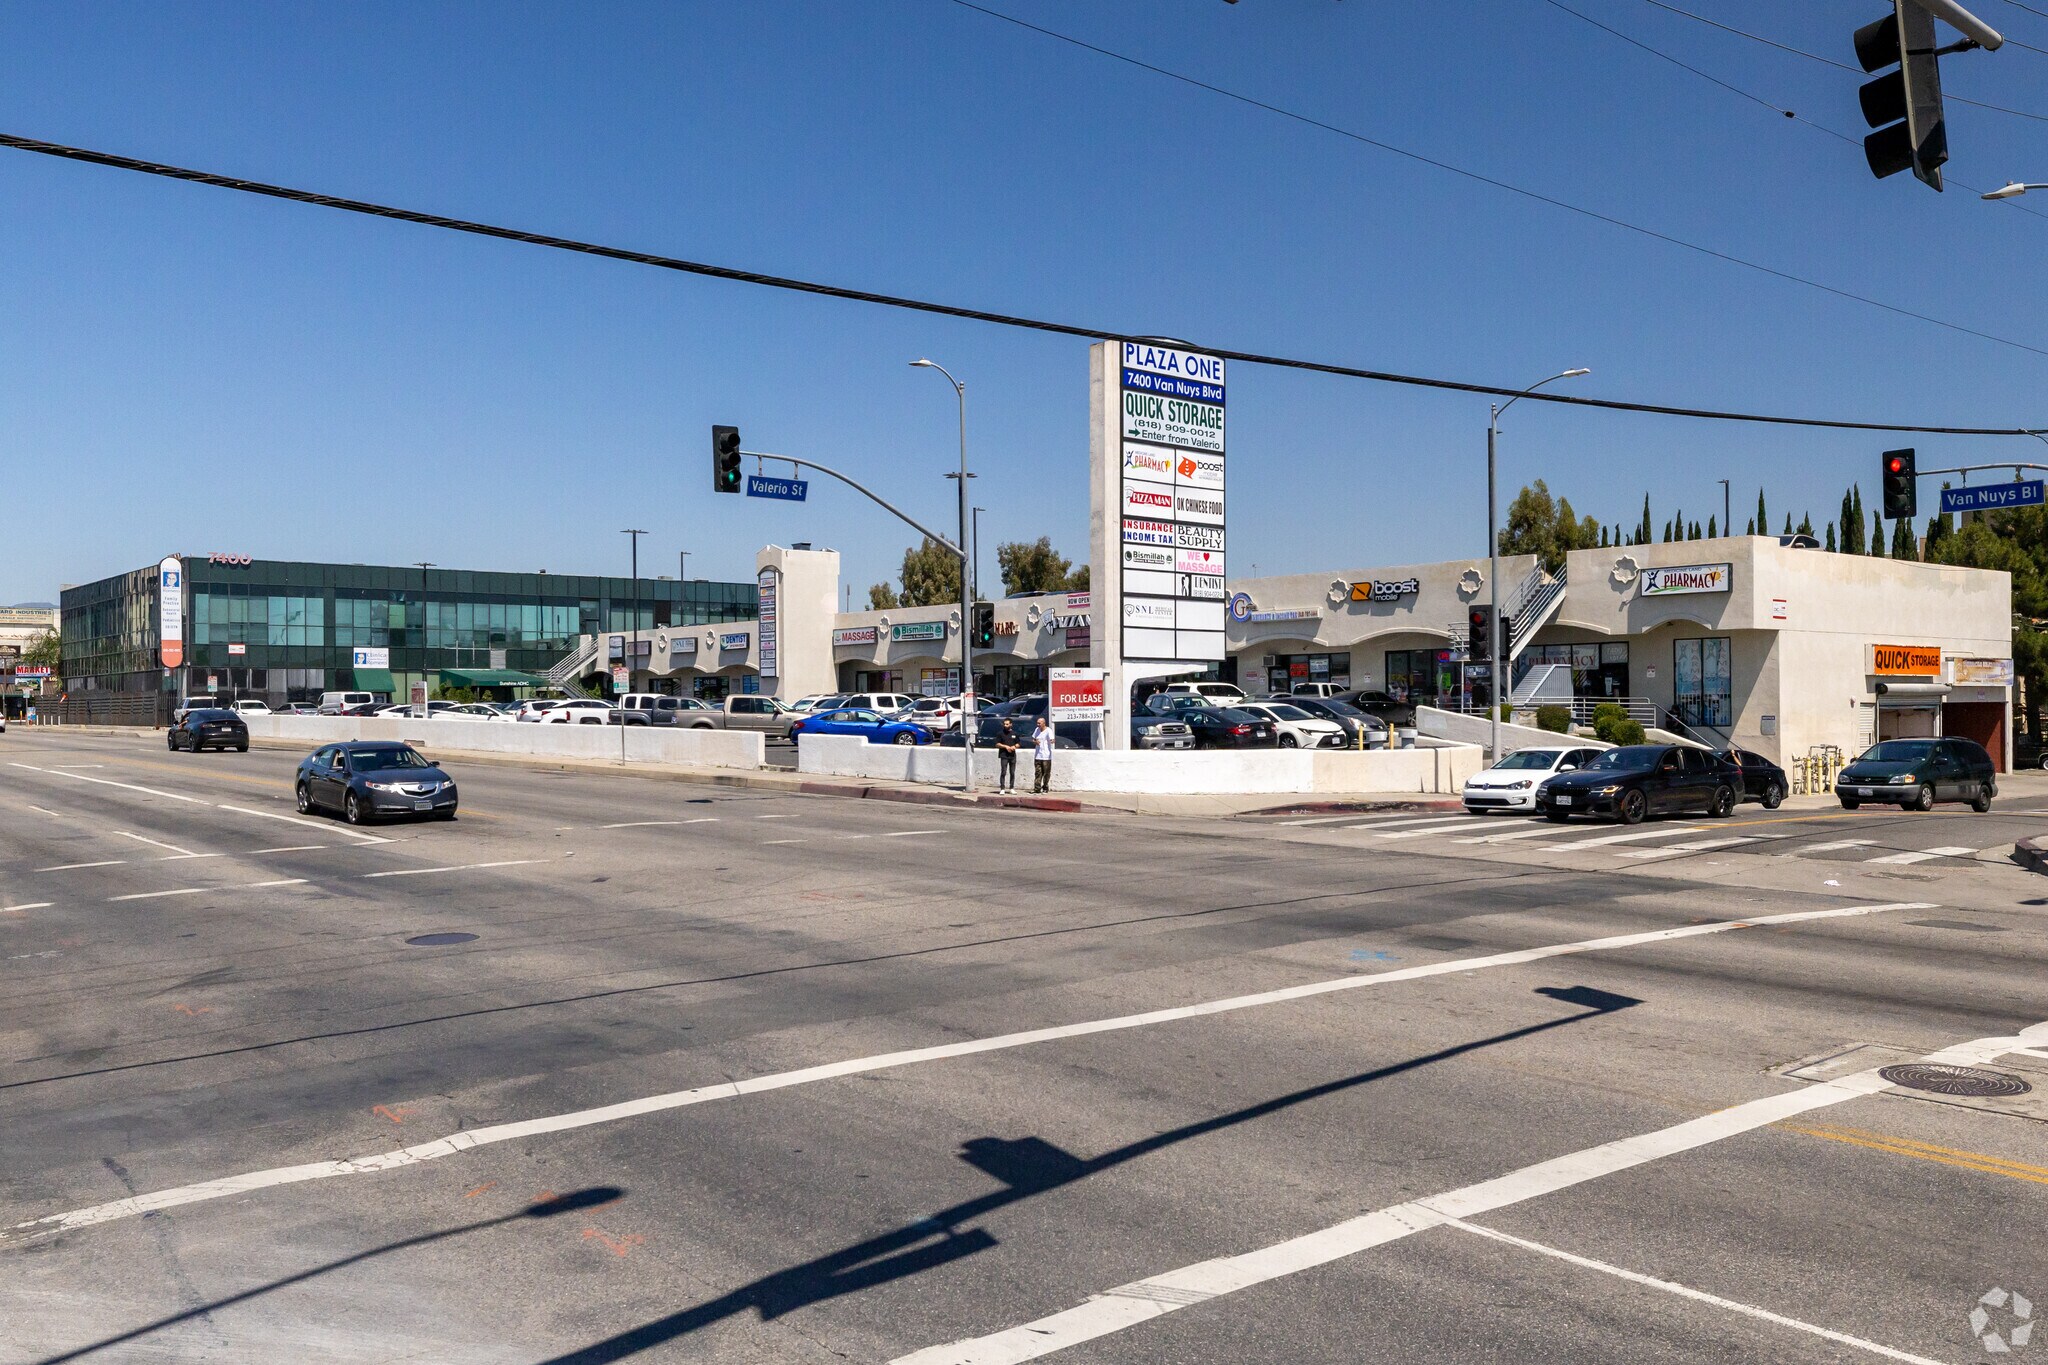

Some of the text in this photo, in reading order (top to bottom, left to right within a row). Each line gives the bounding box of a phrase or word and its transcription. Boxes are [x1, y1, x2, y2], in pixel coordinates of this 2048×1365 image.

[1125, 342, 1221, 381] PLAZA ONE
[1127, 372, 1222, 400] 7400 Van Nuys Blvd
[1125, 393, 1222, 430] QUICK STORAGE
[1134, 418, 1216, 438] (818) 909-0012
[1141, 430, 1220, 450] Enter from Valerio
[1134, 455, 1169, 473] PHARMACY
[1197, 460, 1223, 472] boost
[752, 480, 803, 496] Valerio St
[1132, 492, 1171, 506] PIZZA MAN
[1947, 486, 2037, 506] Van Nuys Bl
[1185, 498, 1208, 513] CHINESE
[1208, 501, 1222, 515] FOOD
[1123, 520, 1173, 533] INSURANCE
[1178, 525, 1223, 539] BEAUTY
[1123, 531, 1173, 544] INCOME TAX
[1178, 536, 1222, 549] SUPPLY
[207, 552, 253, 565] 7400
[1133, 551, 1165, 560] Bismillah
[1187, 551, 1200, 561] WE
[1178, 561, 1223, 574] MASSAGE
[1194, 576, 1222, 589] DENTIST
[1664, 571, 1717, 588] PHARMACY
[1374, 580, 1418, 594] boost
[1375, 593, 1398, 601] mobile
[1135, 604, 1154, 615] SNL
[901, 624, 934, 634] Bismillah
[725, 634, 746, 644] DENTIST
[841, 631, 875, 641] MASSAGE
[1875, 650, 1939, 670] QUICK STORAGE
[16, 666, 49, 674] MARKET
[1060, 693, 1103, 703] FOR LEASE
